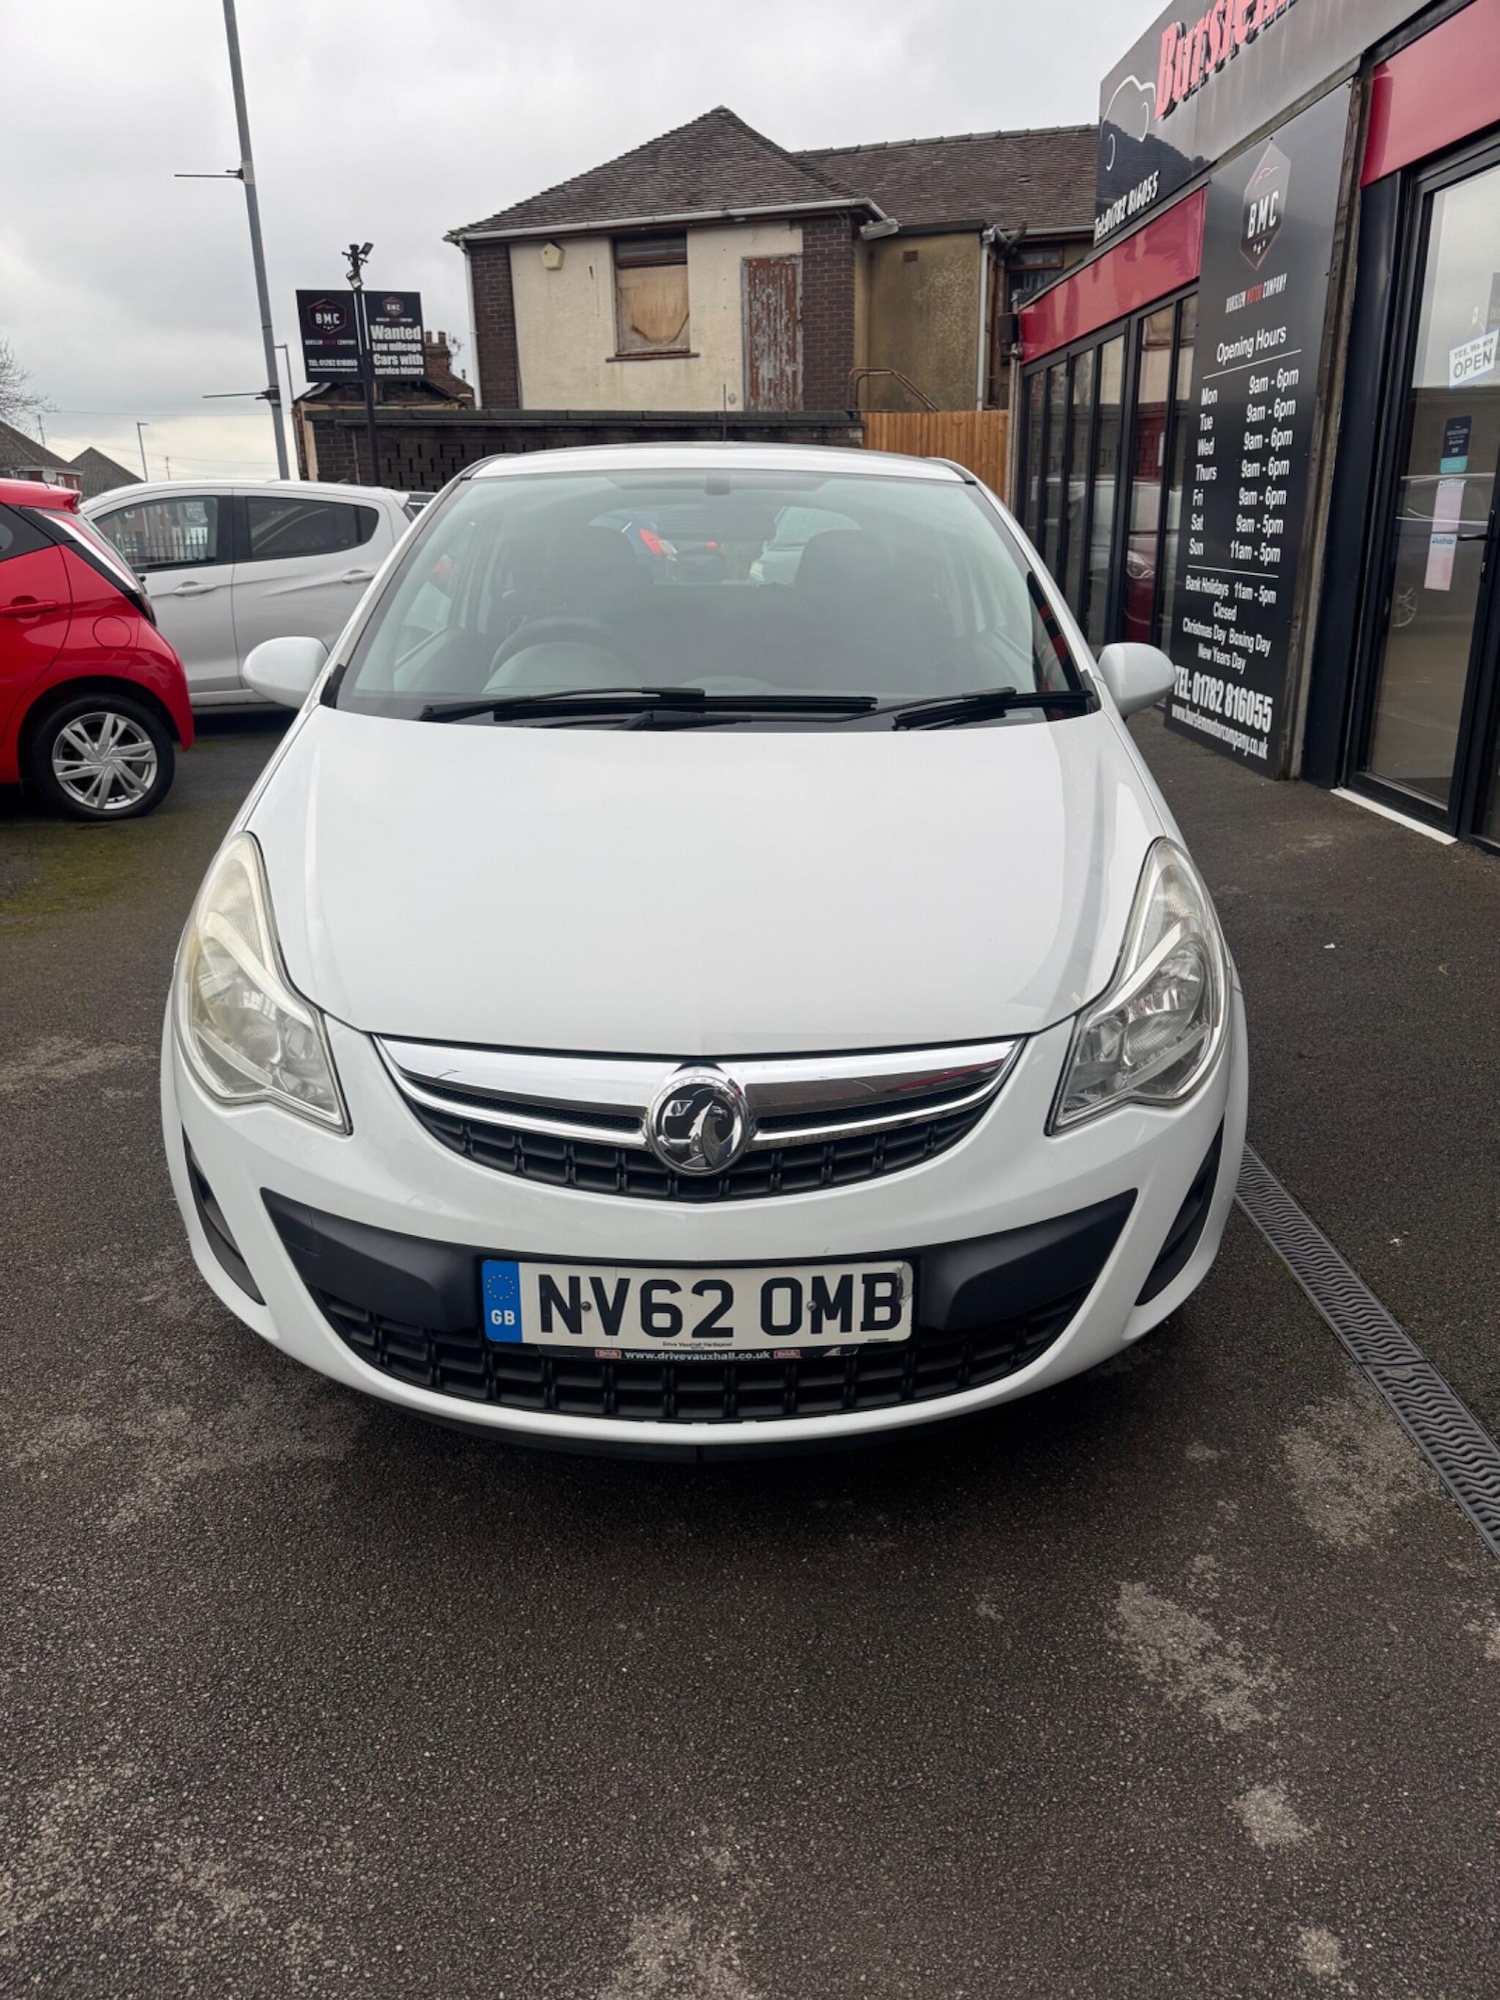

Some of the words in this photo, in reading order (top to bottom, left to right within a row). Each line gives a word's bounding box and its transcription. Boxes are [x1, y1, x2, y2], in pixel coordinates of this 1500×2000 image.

[1127, 170, 1160, 215] 816055
[1247, 190, 1279, 239] BMC
[1225, 290, 1247, 313] BURSLEM
[1262, 273, 1287, 299] COMPANY
[315, 312, 340, 324] BMC
[370, 325, 422, 340] Wanted
[1217, 336, 1254, 366] Opening
[1255, 326, 1287, 351] Hours
[1483, 337, 1494, 347] are
[372, 342, 388, 351] Low
[388, 342, 422, 352] mileage
[373, 354, 398, 365] Cars
[400, 354, 424, 365] with
[375, 367, 400, 375] service
[400, 367, 424, 376] history
[1453, 348, 1492, 378] OPEN
[1201, 388, 1218, 406] Mon
[1249, 375, 1268, 394] 9am
[1276, 368, 1299, 392] 6pm
[1200, 413, 1213, 431] Tue
[1246, 404, 1265, 422] 9am
[1274, 398, 1296, 422] 6pm
[1198, 437, 1215, 456] Wed
[1243, 431, 1263, 450] 9am
[1271, 427, 1293, 452] 6pm
[1196, 464, 1217, 481] Thurs
[1241, 459, 1260, 478] 9am
[1268, 456, 1290, 481] 6pm
[1192, 489, 1204, 506] Fri
[1239, 487, 1257, 506] 9am
[1265, 486, 1286, 510] 6pm
[1191, 514, 1204, 531] Sat
[1236, 514, 1255, 533] 9am
[1262, 514, 1283, 538] 5pm
[1189, 538, 1203, 555] Sun
[1230, 540, 1252, 560] 11am
[1260, 542, 1281, 566] 5pm
[1186, 574, 1201, 591] Bank
[1202, 577, 1229, 600] Holidays
[1235, 581, 1253, 600] 11am
[1259, 585, 1276, 607] 5pm
[1213, 601, 1237, 621] Closed
[1183, 617, 1212, 638] Christmas
[1213, 624, 1227, 646] Day
[1229, 628, 1254, 653] Boxing
[1255, 634, 1272, 657] Day
[1198, 643, 1212, 660] New
[1212, 646, 1231, 666] Years
[1232, 652, 1246, 675] Day
[1192, 671, 1224, 714] 01782
[1224, 683, 1273, 733] 816055
[490, 1309, 516, 1327] GB
[538, 1273, 735, 1339] NV62
[759, 1273, 900, 1336] OMB
[625, 1352, 771, 1360] www.drivevauxhall.co.uk
